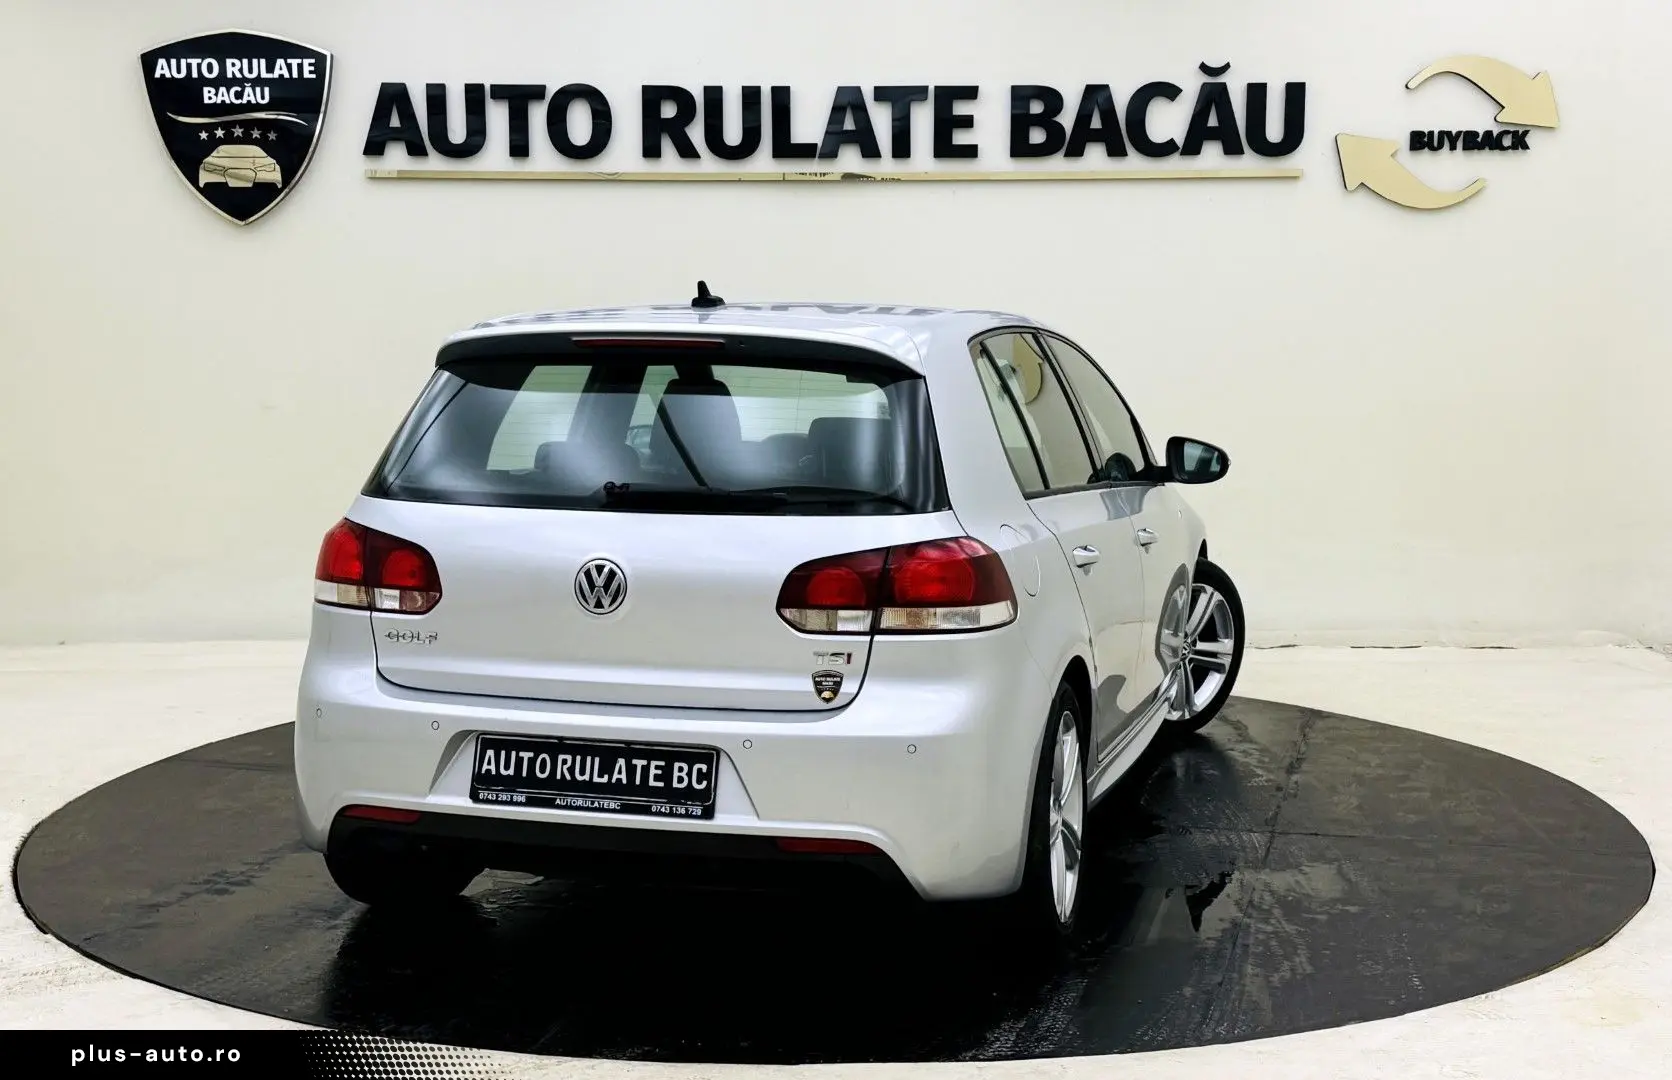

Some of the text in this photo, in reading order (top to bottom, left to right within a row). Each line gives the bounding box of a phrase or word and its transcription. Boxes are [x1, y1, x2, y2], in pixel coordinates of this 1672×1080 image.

[155, 58, 316, 79] AUTO RULATE
[203, 83, 270, 104] BACĂU
[363, 61, 1306, 159] AUTO RULATE BACĂU
[1409, 129, 1530, 151] BUYBACK
[384, 628, 438, 645] GOLF
[813, 651, 852, 665] TSI
[481, 749, 708, 790] AUTO RULATE BC
[479, 792, 497, 800] 0743
[555, 797, 621, 810] AUTORULATEBC
[651, 805, 670, 814] 0743
